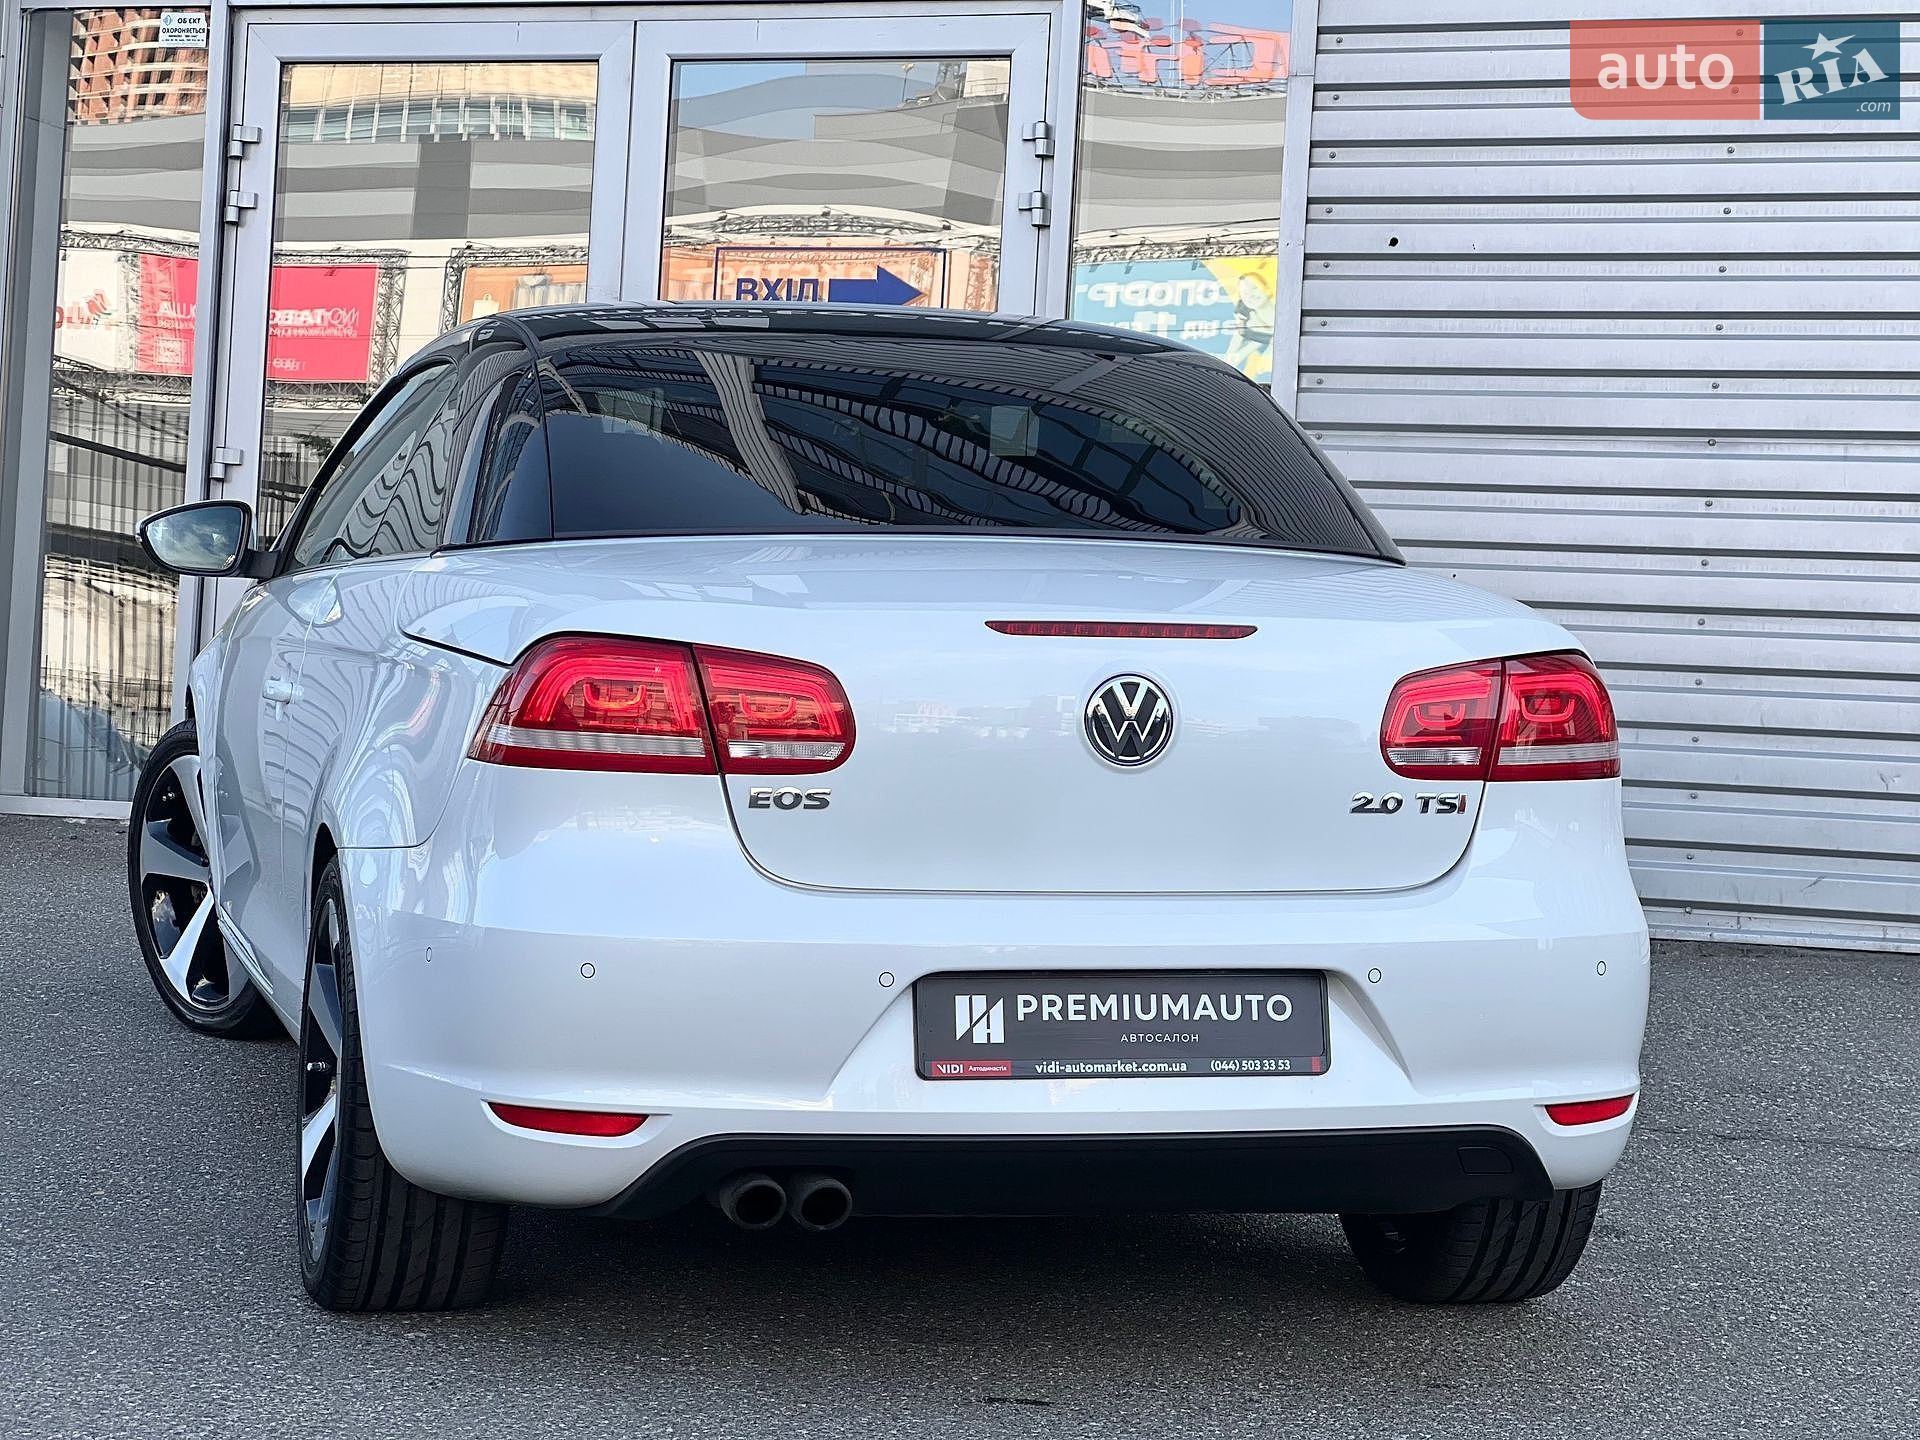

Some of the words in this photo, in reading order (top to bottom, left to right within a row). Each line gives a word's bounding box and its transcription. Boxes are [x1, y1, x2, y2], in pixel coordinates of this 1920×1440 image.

[748, 786, 832, 810] EOS
[1415, 792, 1467, 814] TSI
[1017, 994, 1293, 1021] PREMIUMAUTO
[1120, 1033, 1199, 1043] АВТОСАЛОН
[937, 1064, 964, 1073] VIDI
[1035, 1060, 1187, 1074] vidi-automarket.com.ua
[1210, 1060, 1240, 1072] (044)
[1241, 1060, 1261, 1071] 503
